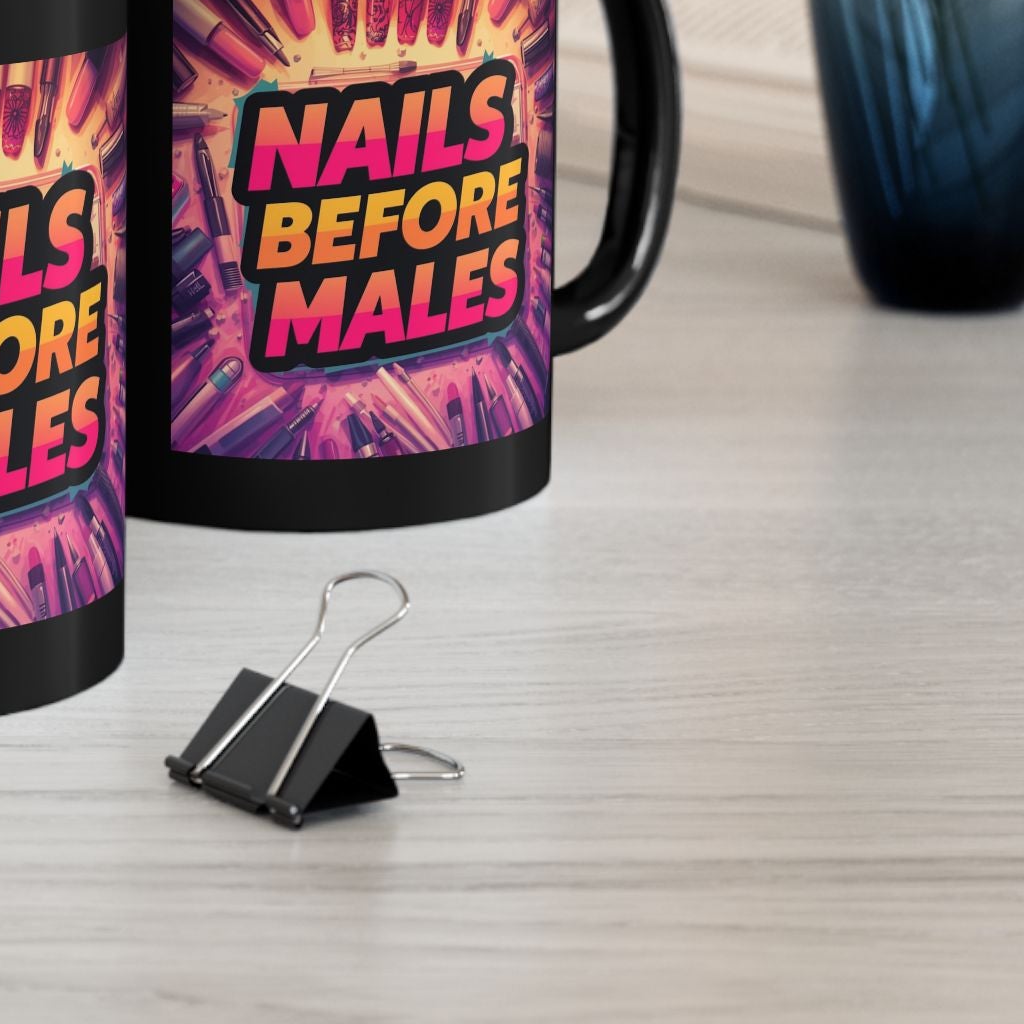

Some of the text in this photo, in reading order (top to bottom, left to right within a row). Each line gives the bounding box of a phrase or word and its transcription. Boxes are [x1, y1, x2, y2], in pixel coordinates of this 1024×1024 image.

[249, 75, 507, 192] NAILS
[257, 158, 522, 270] BEFORE
[265, 238, 519, 358] MALES
